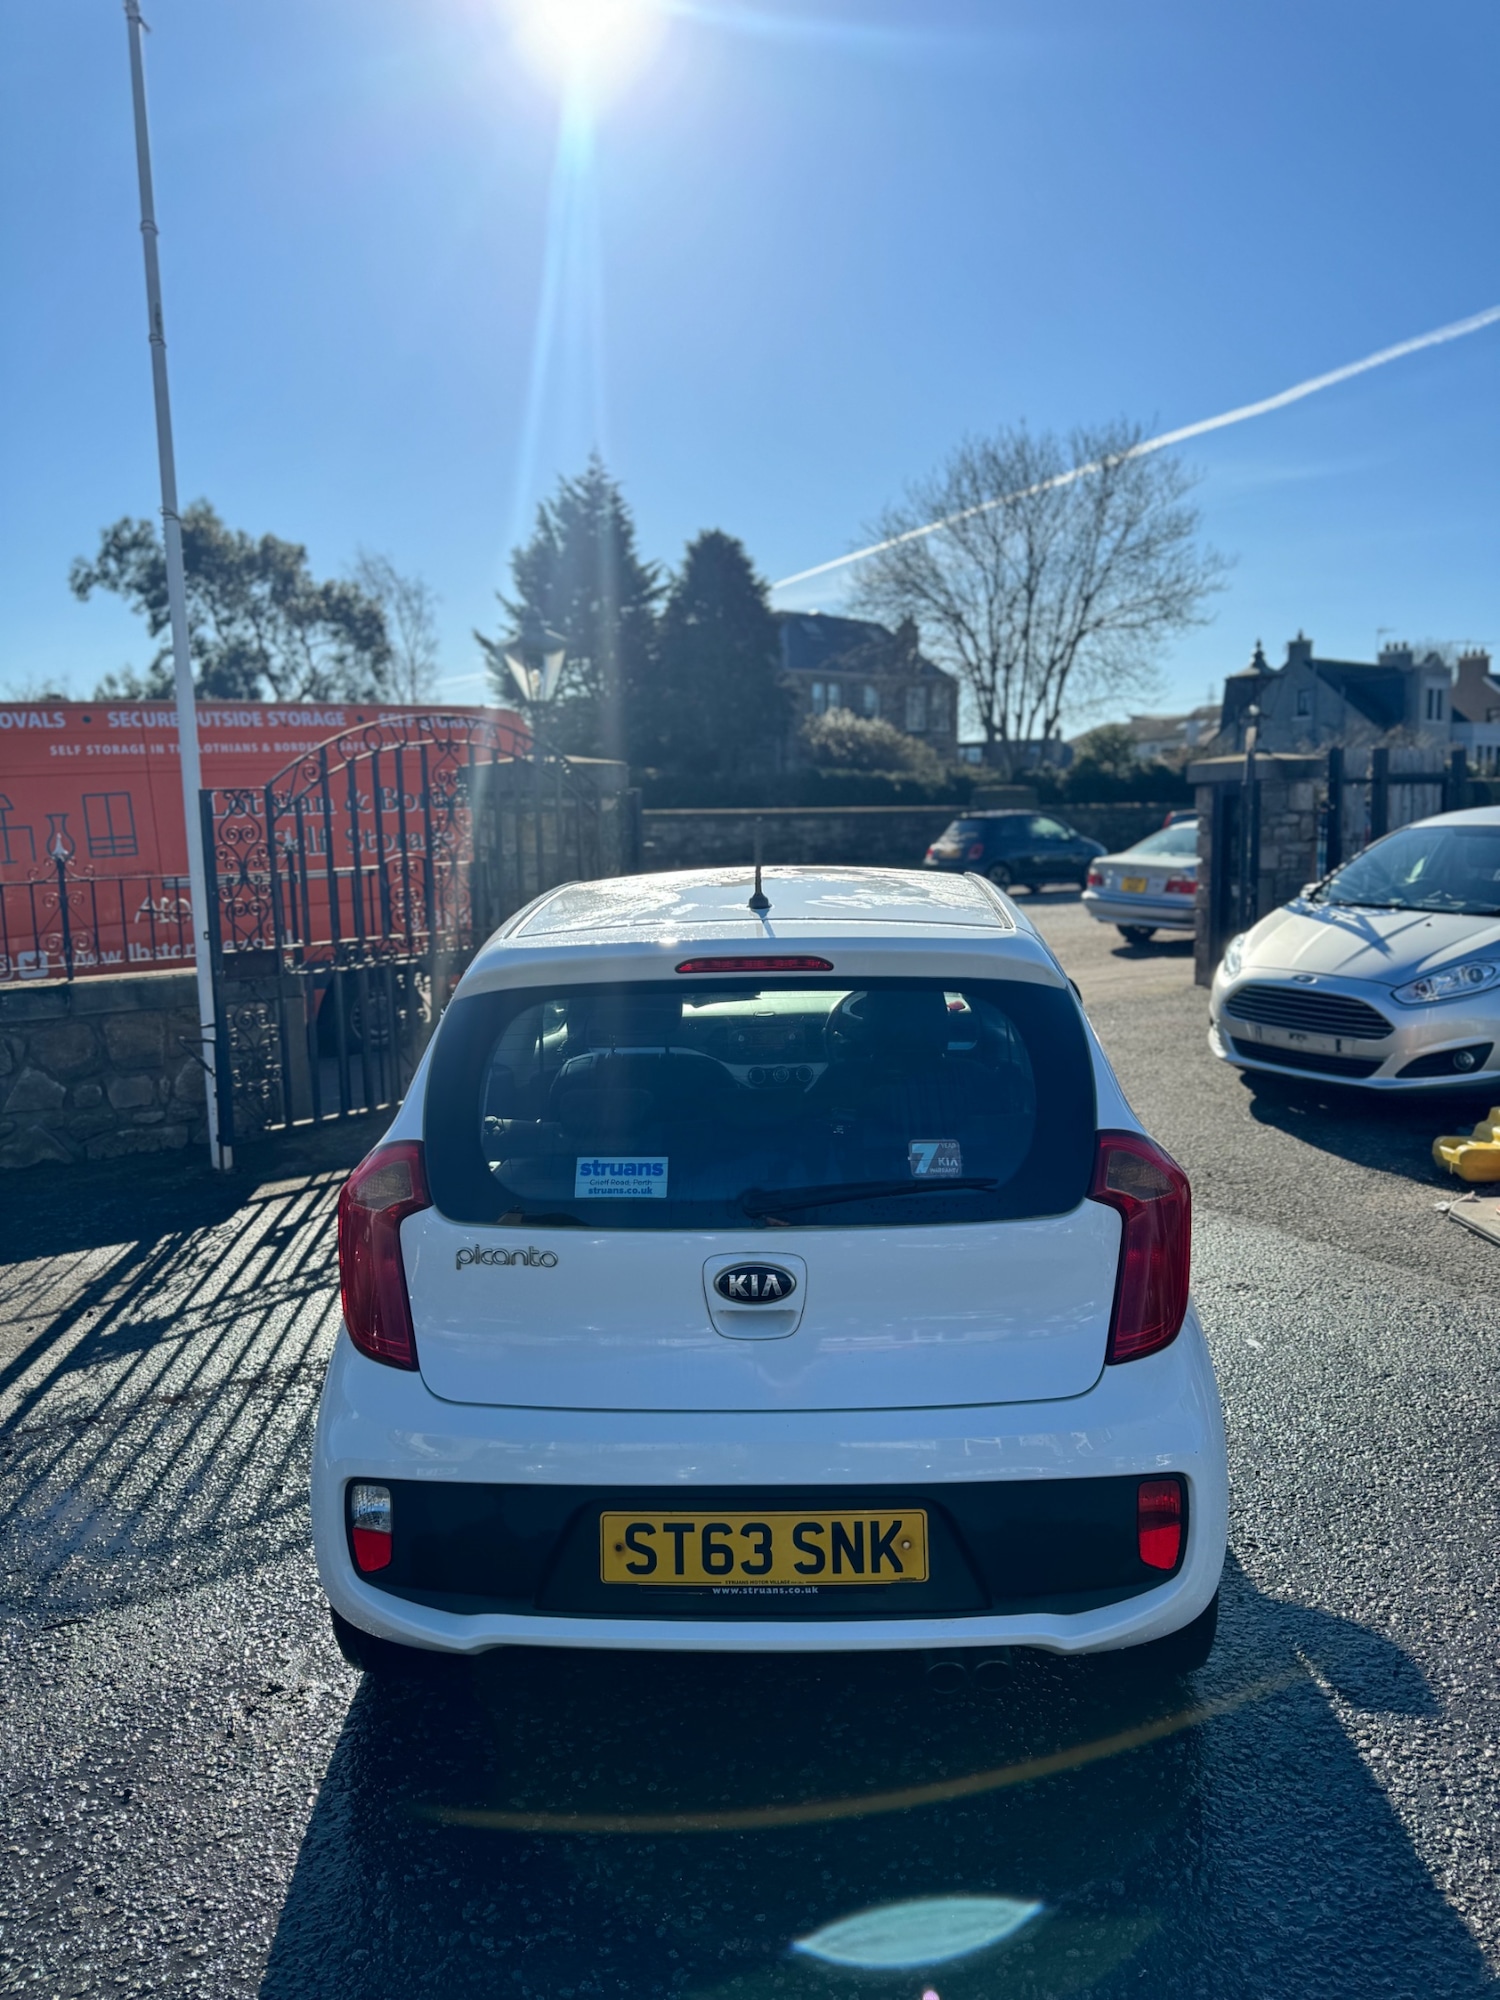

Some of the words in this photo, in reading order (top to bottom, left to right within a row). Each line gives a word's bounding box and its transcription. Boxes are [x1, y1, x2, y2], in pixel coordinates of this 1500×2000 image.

[0, 711, 66, 729] OVALS
[107, 711, 180, 728] SECURE
[197, 711, 263, 727] UTSIDE
[267, 710, 347, 727] STORAGE
[50, 745, 82, 756] SELF
[86, 744, 146, 755] STORAGE
[150, 743, 165, 755] IN
[262, 743, 270, 752] &
[912, 1143, 939, 1173] 7
[938, 1158, 958, 1166] KIA
[580, 1160, 664, 1176] struans
[588, 1187, 653, 1195] struans.co.uk
[456, 1244, 558, 1270] picanto
[728, 1274, 783, 1297] KIA
[625, 1522, 773, 1575] ST63
[792, 1520, 903, 1574] SNK
